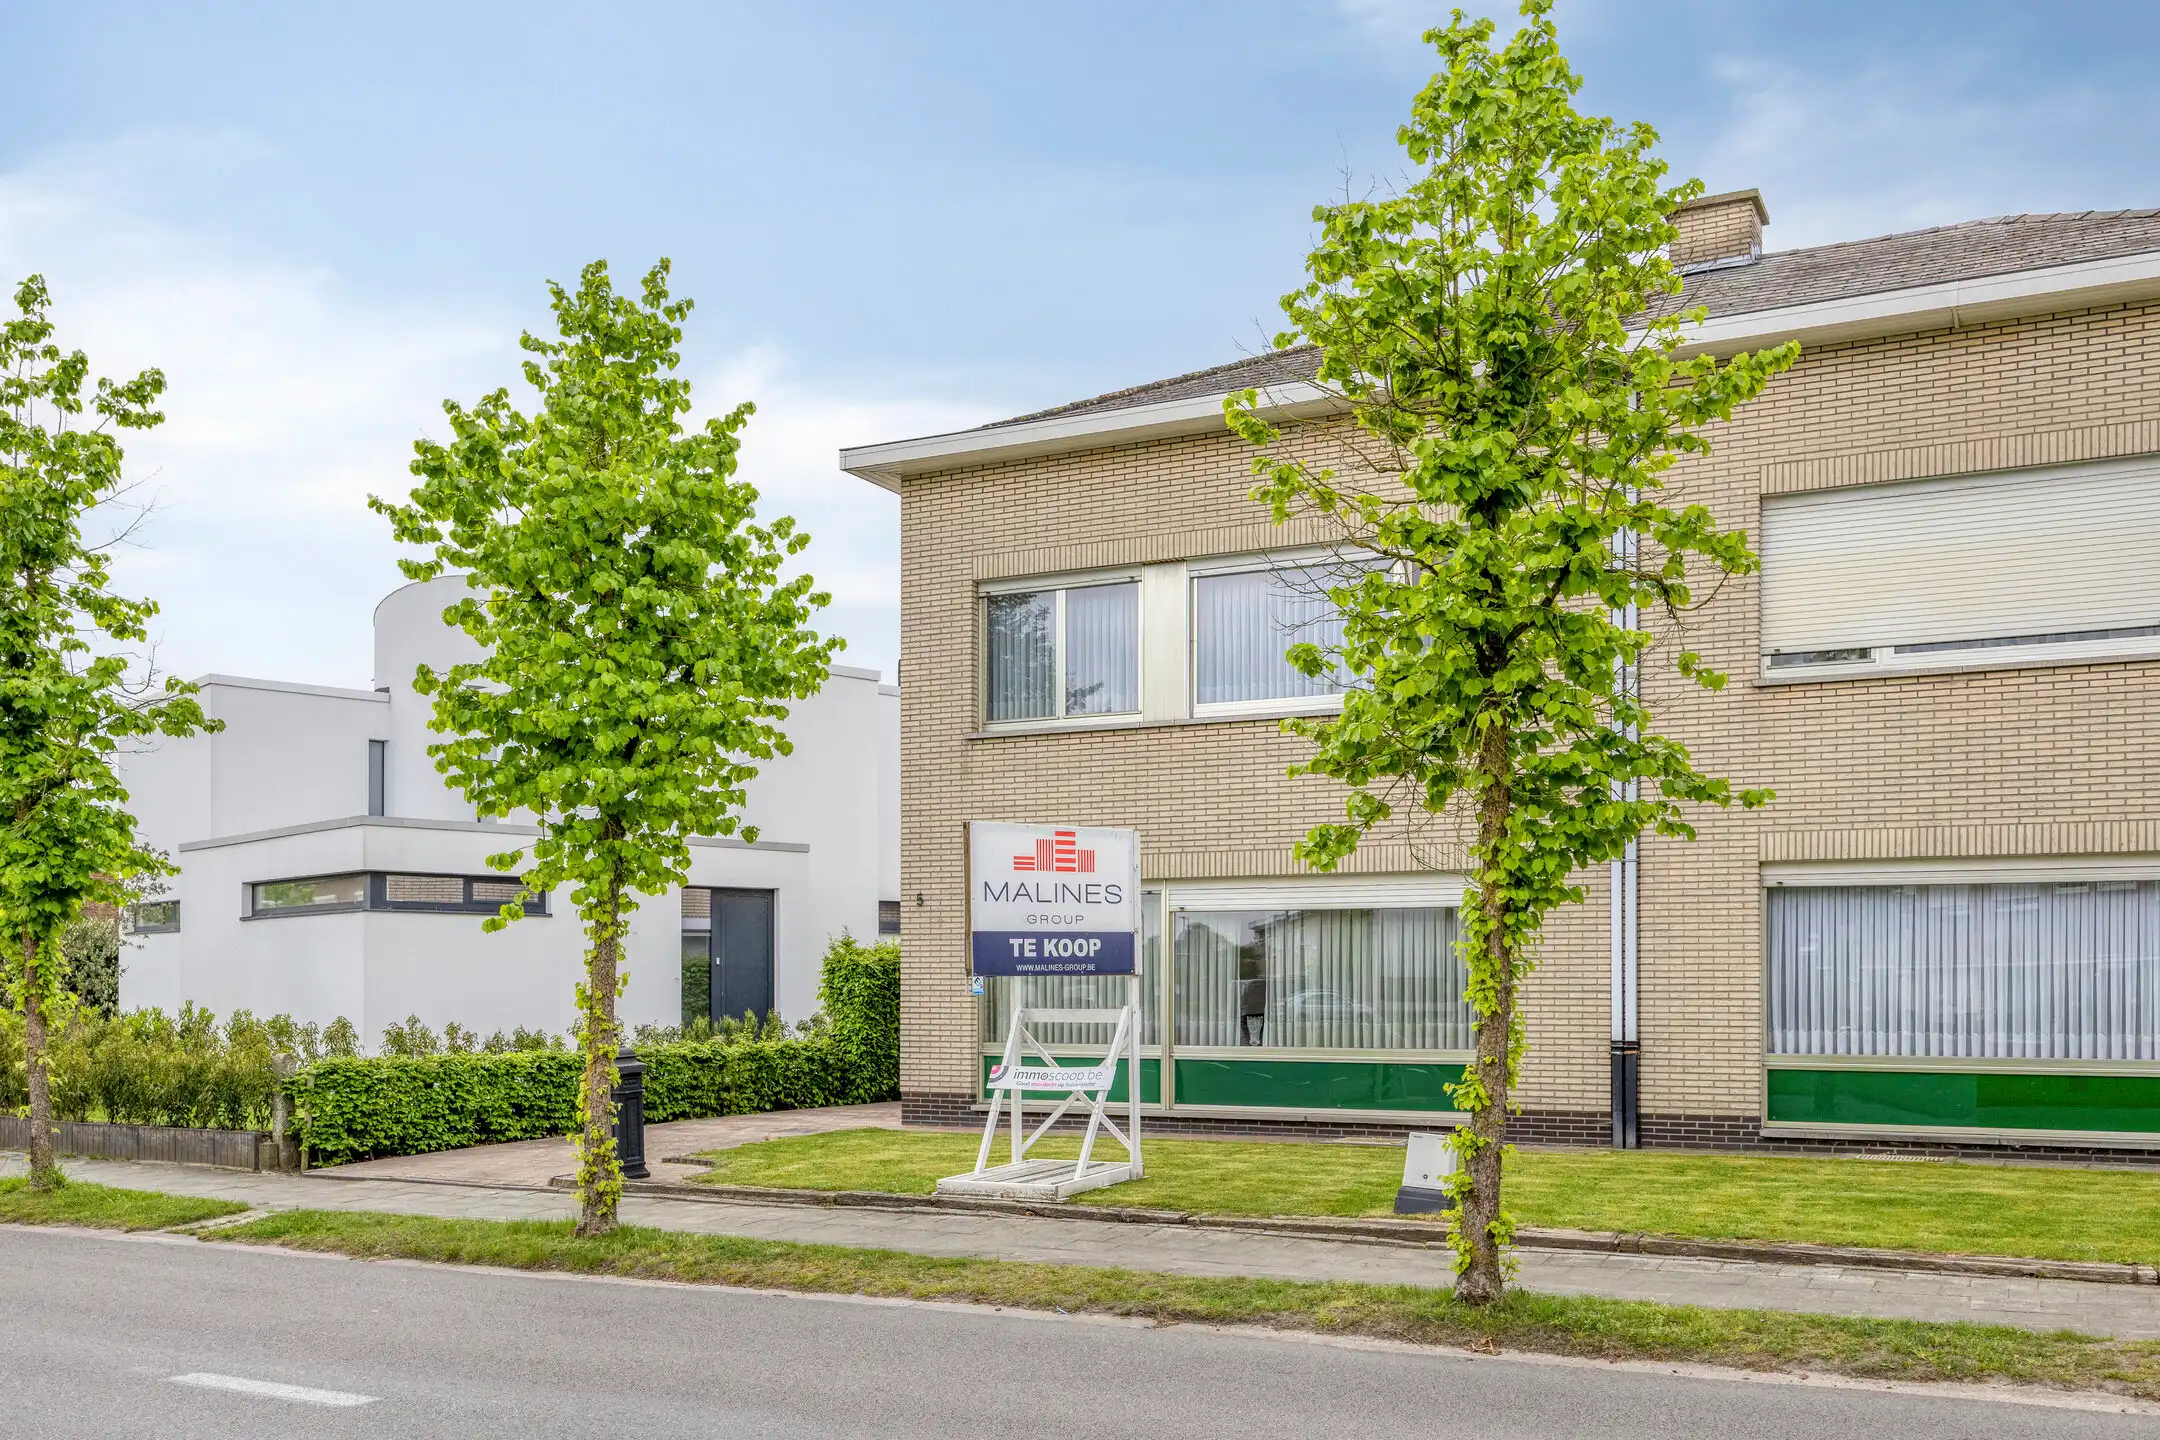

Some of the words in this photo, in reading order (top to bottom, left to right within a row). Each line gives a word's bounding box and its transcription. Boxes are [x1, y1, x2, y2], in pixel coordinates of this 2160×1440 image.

[983, 880, 1122, 905] MALINES
[917, 893, 924, 907] 5
[1026, 914, 1085, 925] GROUP
[1009, 938, 1037, 958] TE
[1043, 938, 1102, 958] KOOP
[1016, 963, 1096, 972] WWW.MALINES-GROUP.BE
[1013, 1068, 1104, 1082] immoscoop.be
